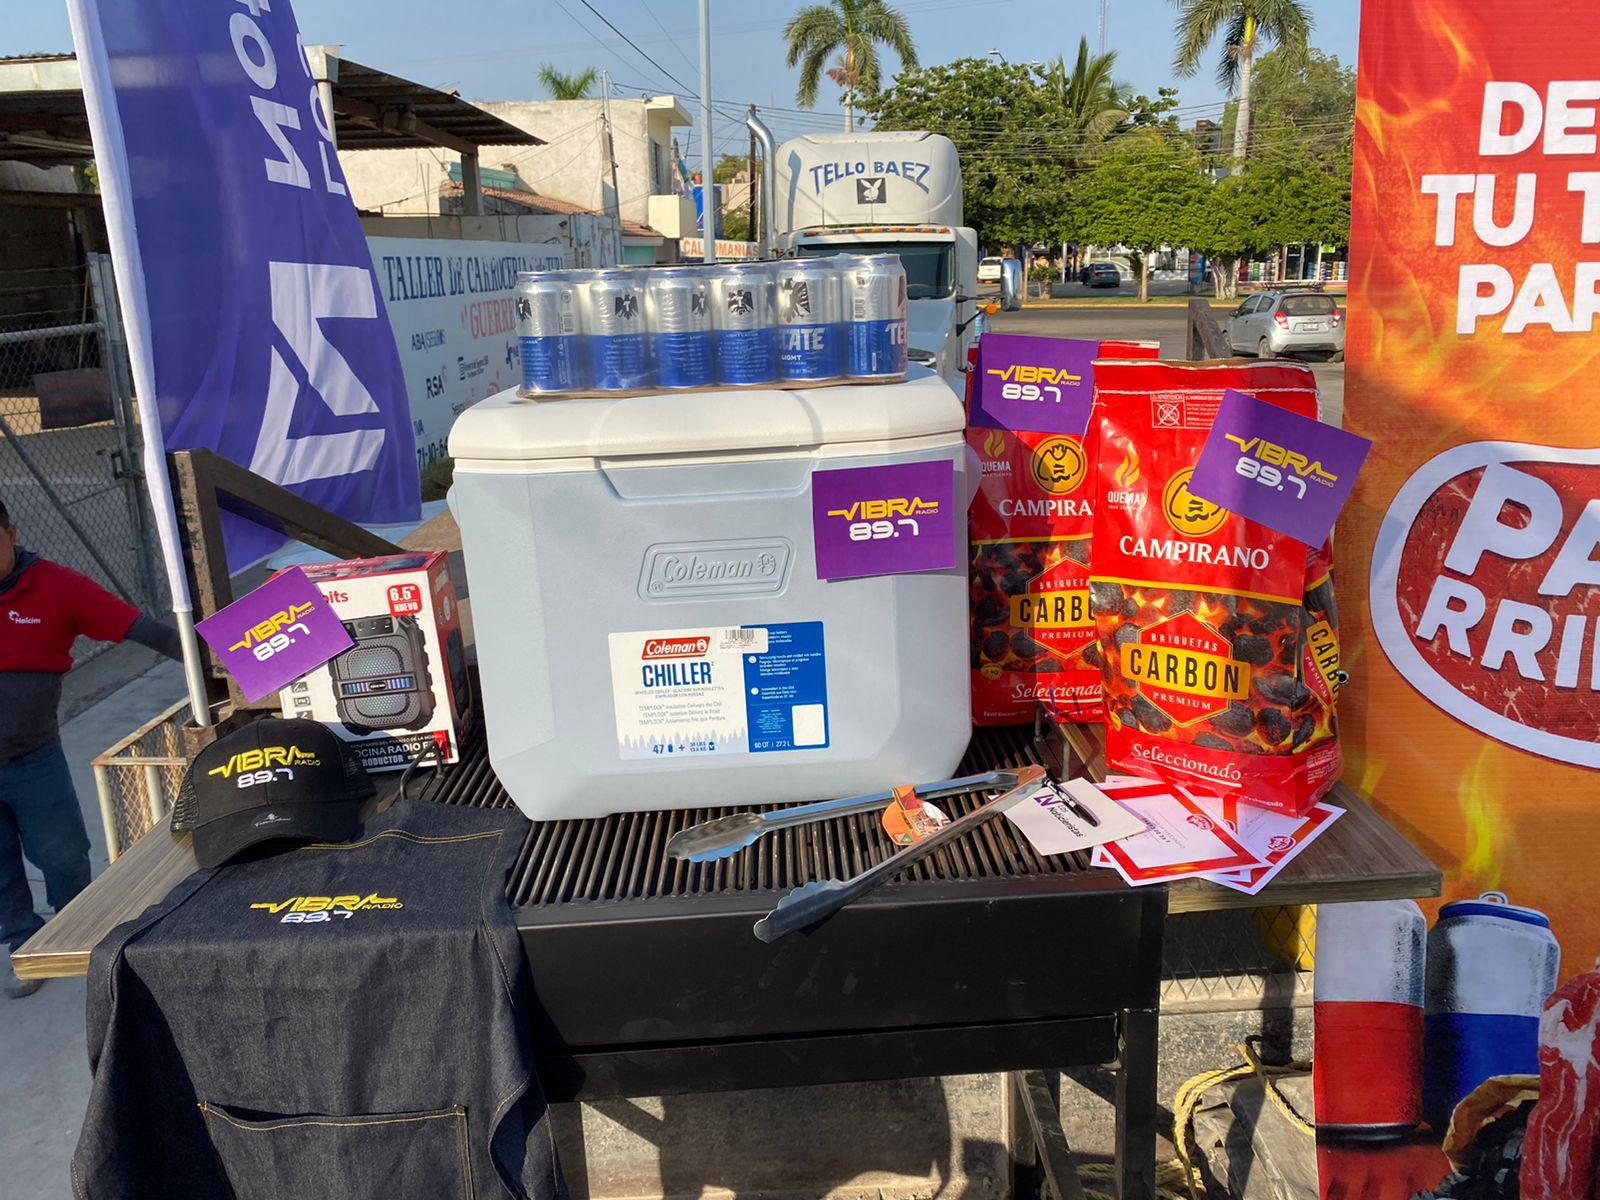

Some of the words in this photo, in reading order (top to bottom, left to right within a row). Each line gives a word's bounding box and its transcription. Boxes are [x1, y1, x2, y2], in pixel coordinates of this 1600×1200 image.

[1478, 80, 1600, 156] DE
[809, 162, 866, 196] TELLO
[874, 161, 930, 195] BAEZ
[1421, 173, 1537, 247] TU
[383, 256, 446, 301] TALLER
[446, 256, 465, 295] DE
[987, 365, 1082, 385] VIBRA
[426, 375, 445, 399] RSA
[1001, 383, 1062, 403] 89.7
[1224, 433, 1338, 482] VIBRA
[1235, 456, 1308, 500] 89.7
[1309, 474, 1335, 488] RADIO
[827, 496, 939, 521] VIBRA
[999, 498, 1095, 518] CAMPIRA
[849, 518, 919, 541] 89.7
[1119, 535, 1270, 570] CAMPIRANO
[664, 553, 754, 583] Coleman
[296, 606, 316, 619] RADIO
[392, 602, 419, 613] NUEVO
[229, 601, 313, 653] VIBRA
[1041, 631, 1095, 640] PREMIUM
[252, 623, 311, 662] 89.7
[646, 640, 696, 655] Coleman
[1151, 633, 1219, 652] BRIQUETAS
[642, 662, 712, 688] CHILLER
[1130, 648, 1240, 694] CARBON
[1304, 655, 1328, 698] PREMIUM
[1152, 690, 1212, 711] PREMIUM
[387, 742, 421, 755] RADIO
[653, 744, 665, 754] 47
[208, 745, 315, 778] VIBRA
[294, 758, 321, 767] RADIO
[1131, 743, 1242, 781] Seleccionado
[237, 768, 295, 789] 89.7
[250, 892, 398, 914] VIBRA
[362, 902, 404, 910] RADIO
[280, 910, 354, 924] 89.7
